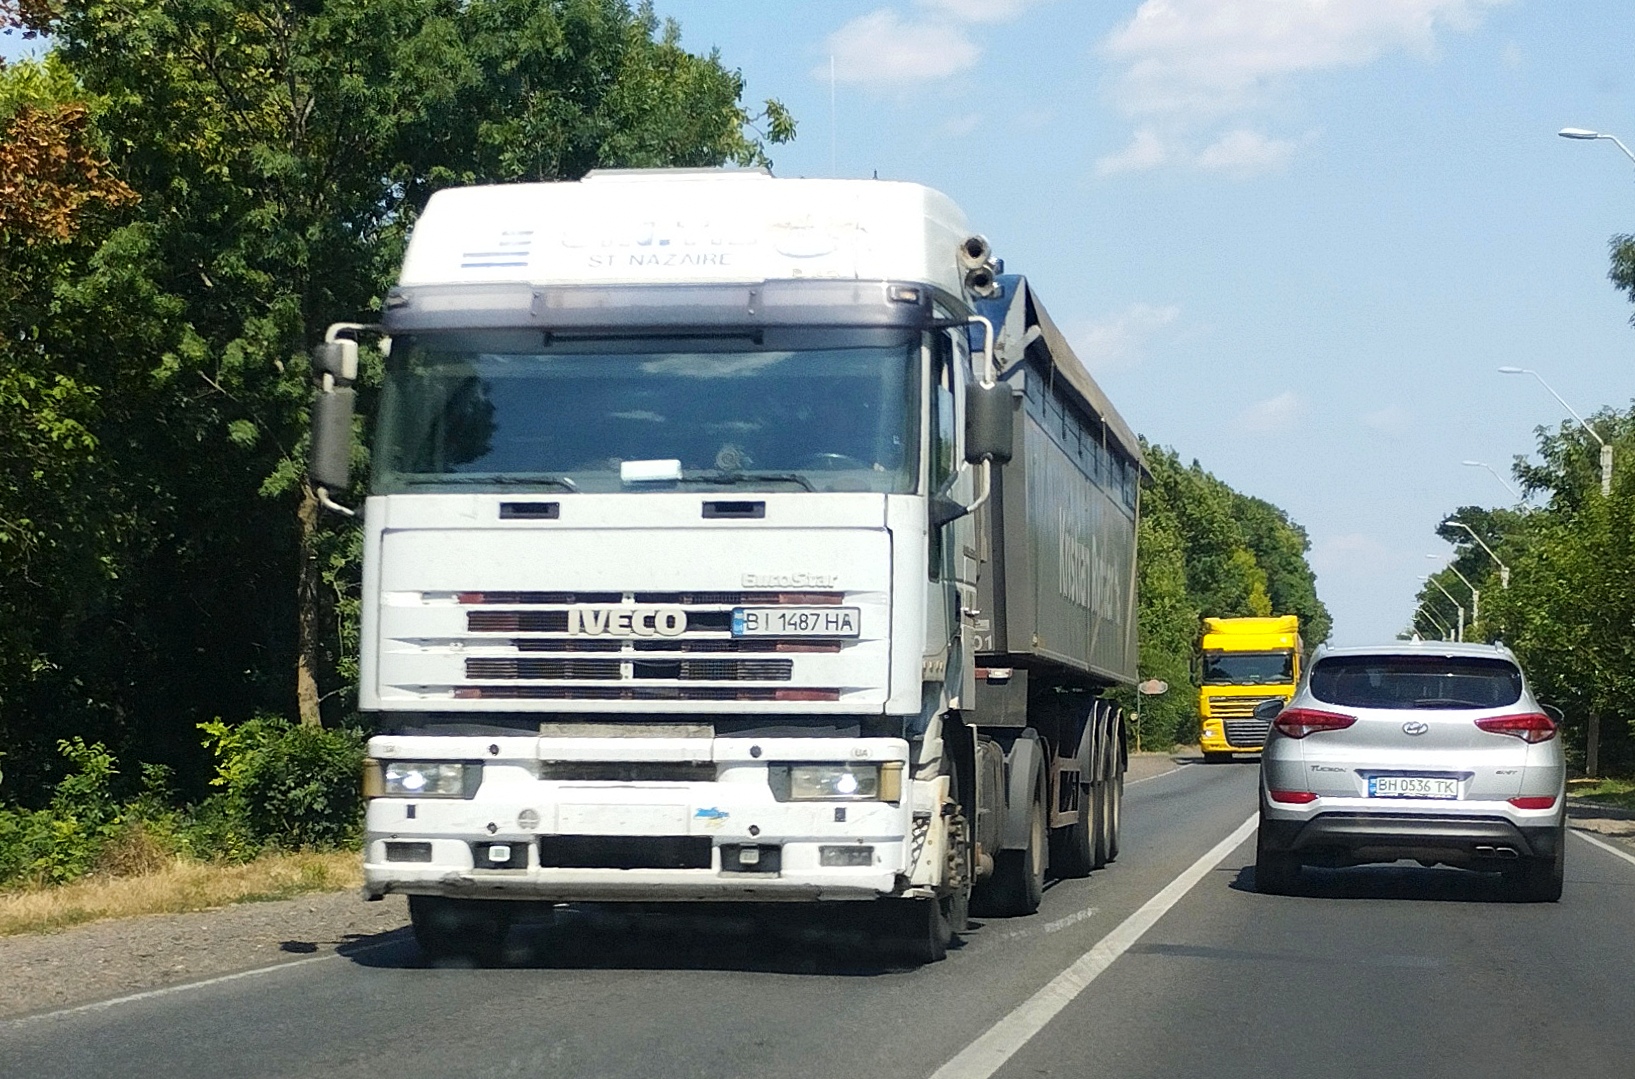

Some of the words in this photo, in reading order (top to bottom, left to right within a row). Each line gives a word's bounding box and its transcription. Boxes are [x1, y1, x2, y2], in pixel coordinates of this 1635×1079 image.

[588, 253, 615, 268] ST
[628, 252, 732, 267] NAZAIRE
[741, 572, 838, 588] EuroStar
[567, 608, 688, 636] IVECO
[745, 613, 769, 631] BI
[778, 612, 820, 631] 1487
[825, 612, 853, 631] HA
[1378, 778, 1398, 792] BH
[1401, 779, 1431, 792] 0536
[1435, 780, 1456, 793] TK
